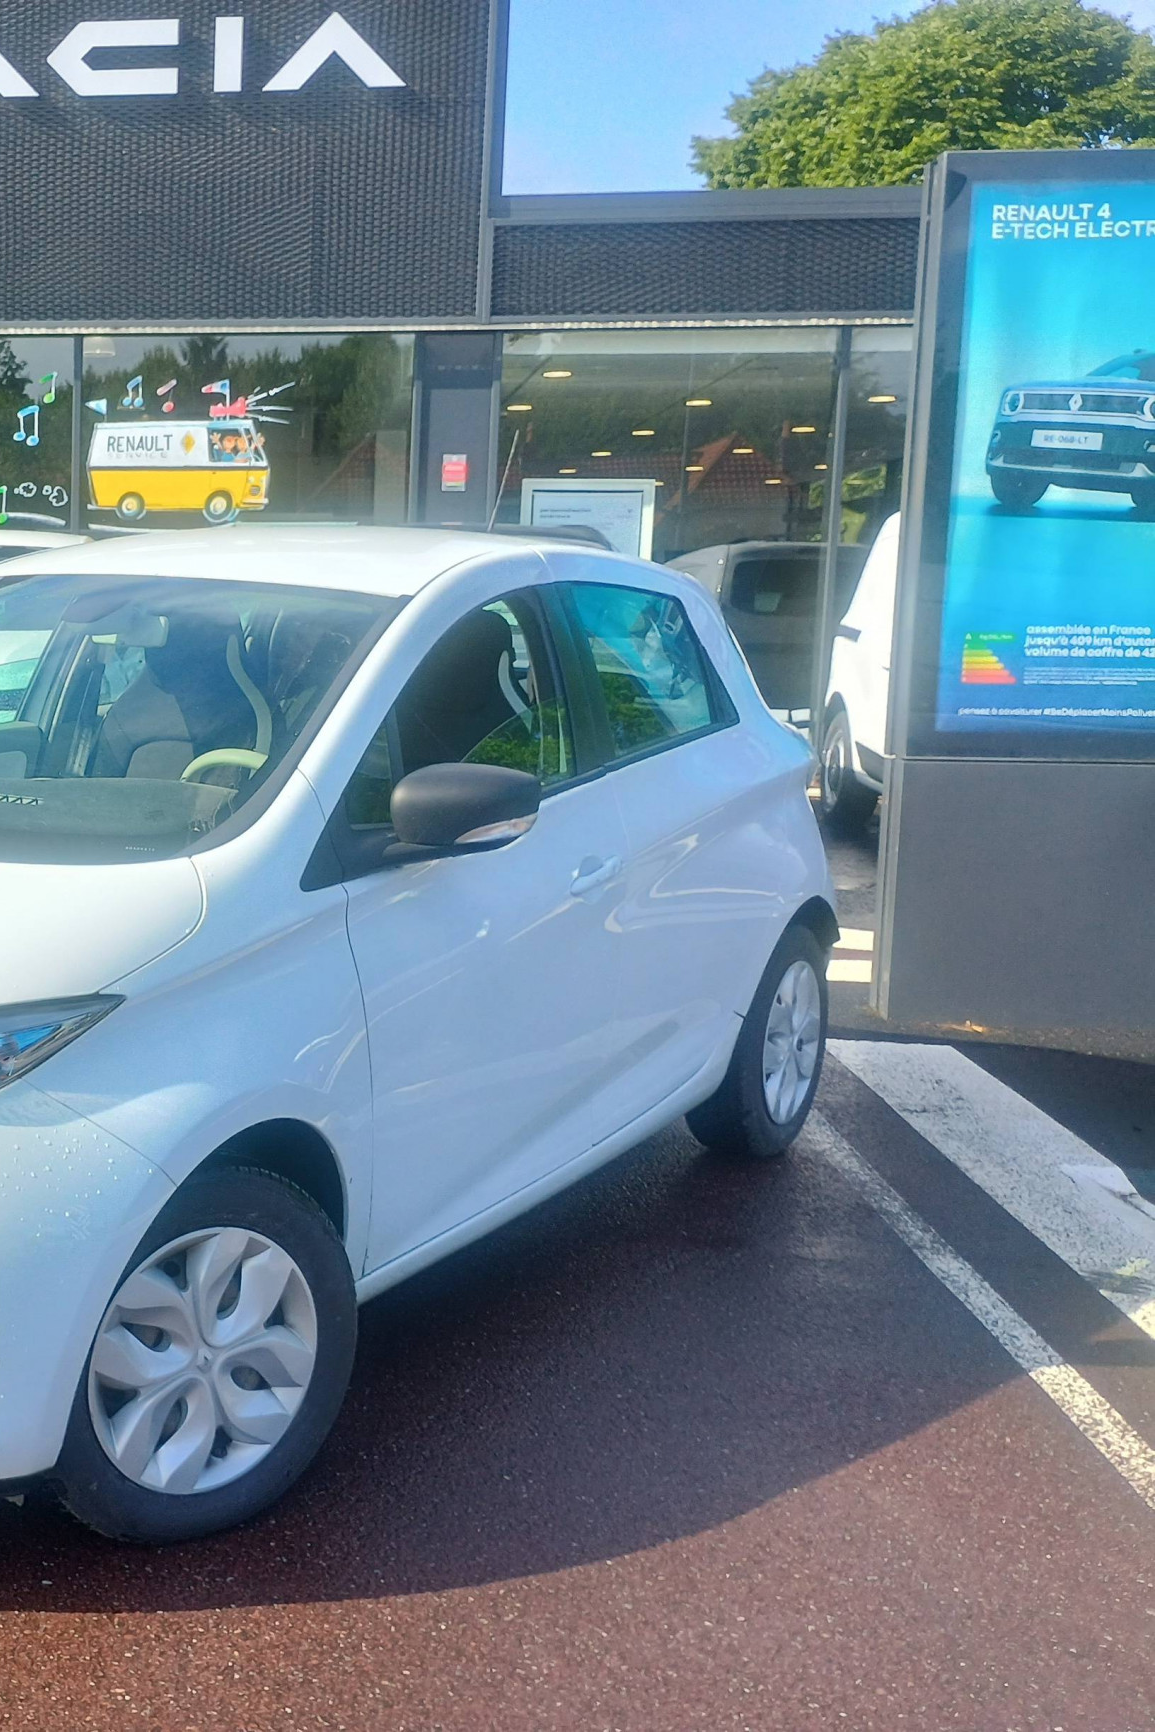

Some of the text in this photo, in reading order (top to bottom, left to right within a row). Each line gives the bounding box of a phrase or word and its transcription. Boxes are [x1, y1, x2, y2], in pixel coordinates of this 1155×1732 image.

[992, 203, 1111, 221] RENAULT 4
[991, 222, 1069, 239] E-TECH
[107, 434, 173, 453] RENAULT
[1092, 626, 1108, 635] en
[1109, 624, 1151, 635] France
[1093, 636, 1112, 646] km
[1025, 646, 1069, 657] volume
[1070, 647, 1085, 657] de
[1087, 647, 1123, 657] coffre
[1124, 647, 1140, 657] de
